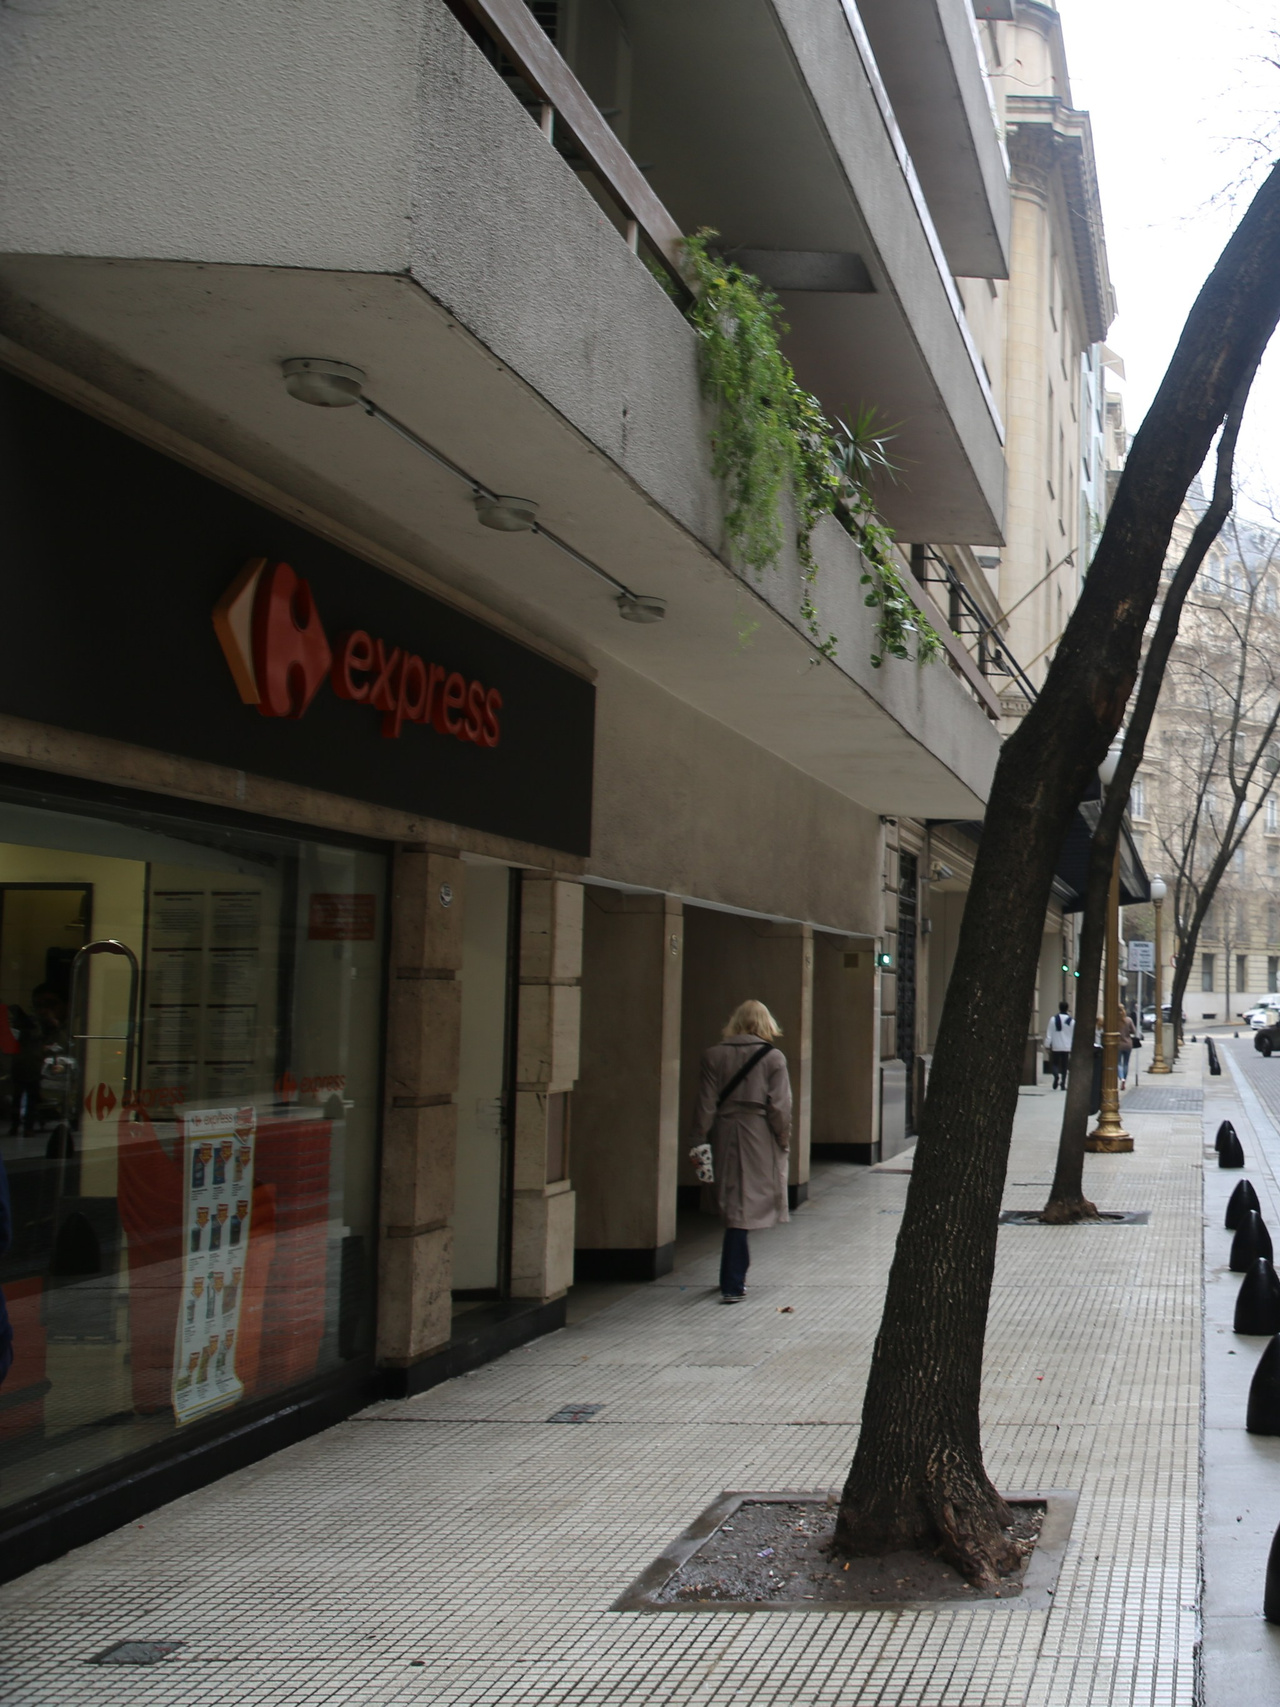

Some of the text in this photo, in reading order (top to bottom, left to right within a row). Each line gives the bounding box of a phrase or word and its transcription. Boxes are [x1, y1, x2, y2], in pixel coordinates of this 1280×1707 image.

[332, 629, 503, 748] express
[121, 1084, 187, 1110] express
[300, 1074, 346, 1098] express
